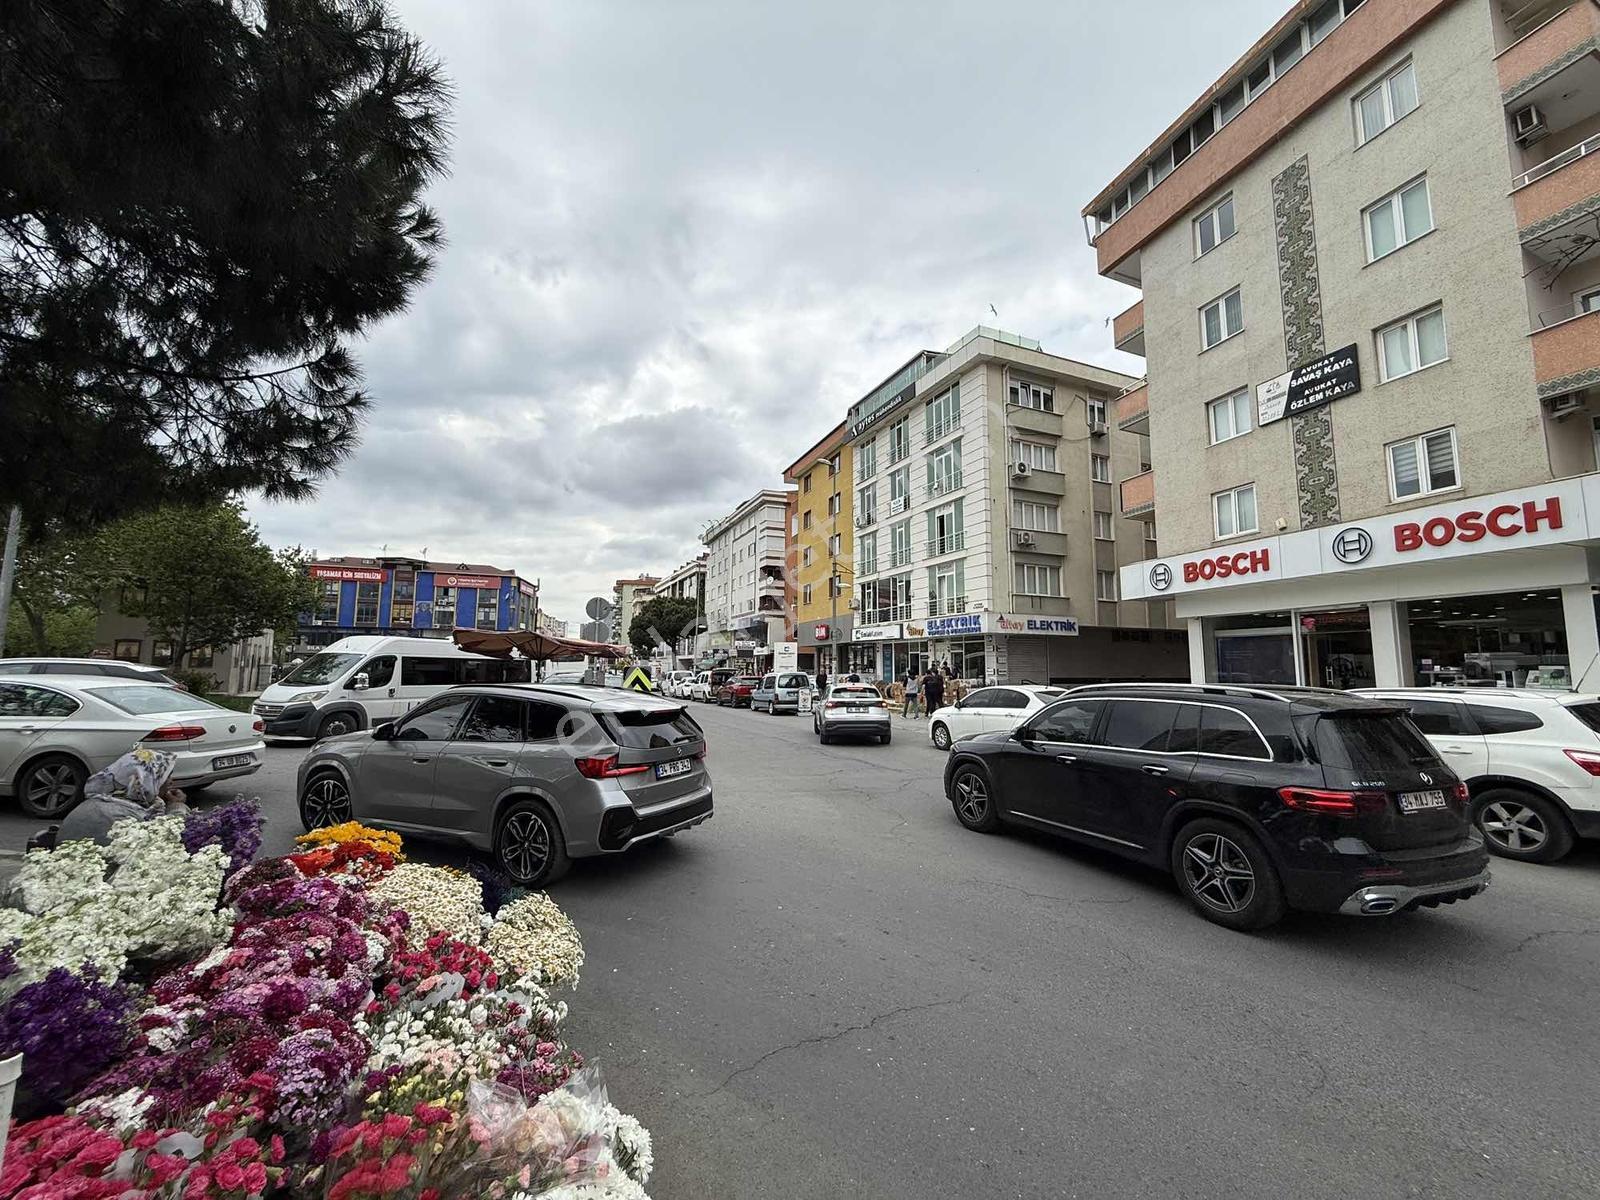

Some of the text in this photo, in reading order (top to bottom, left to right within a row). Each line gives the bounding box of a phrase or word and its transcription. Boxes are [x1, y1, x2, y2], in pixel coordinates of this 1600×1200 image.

[1291, 358, 1354, 387] SAVAŞ KAYA
[1301, 357, 1335, 375] AVUKAT
[1290, 392, 1324, 410] ÖZLEM
[1325, 381, 1355, 398] KAYA
[1304, 378, 1337, 396] AVUKAT
[1393, 496, 1563, 552] BOSCH
[1183, 548, 1270, 583] BOSCH
[1027, 618, 1077, 632] ELEKTRİK
[659, 764, 668, 776] 34
[1402, 794, 1413, 809] 34
